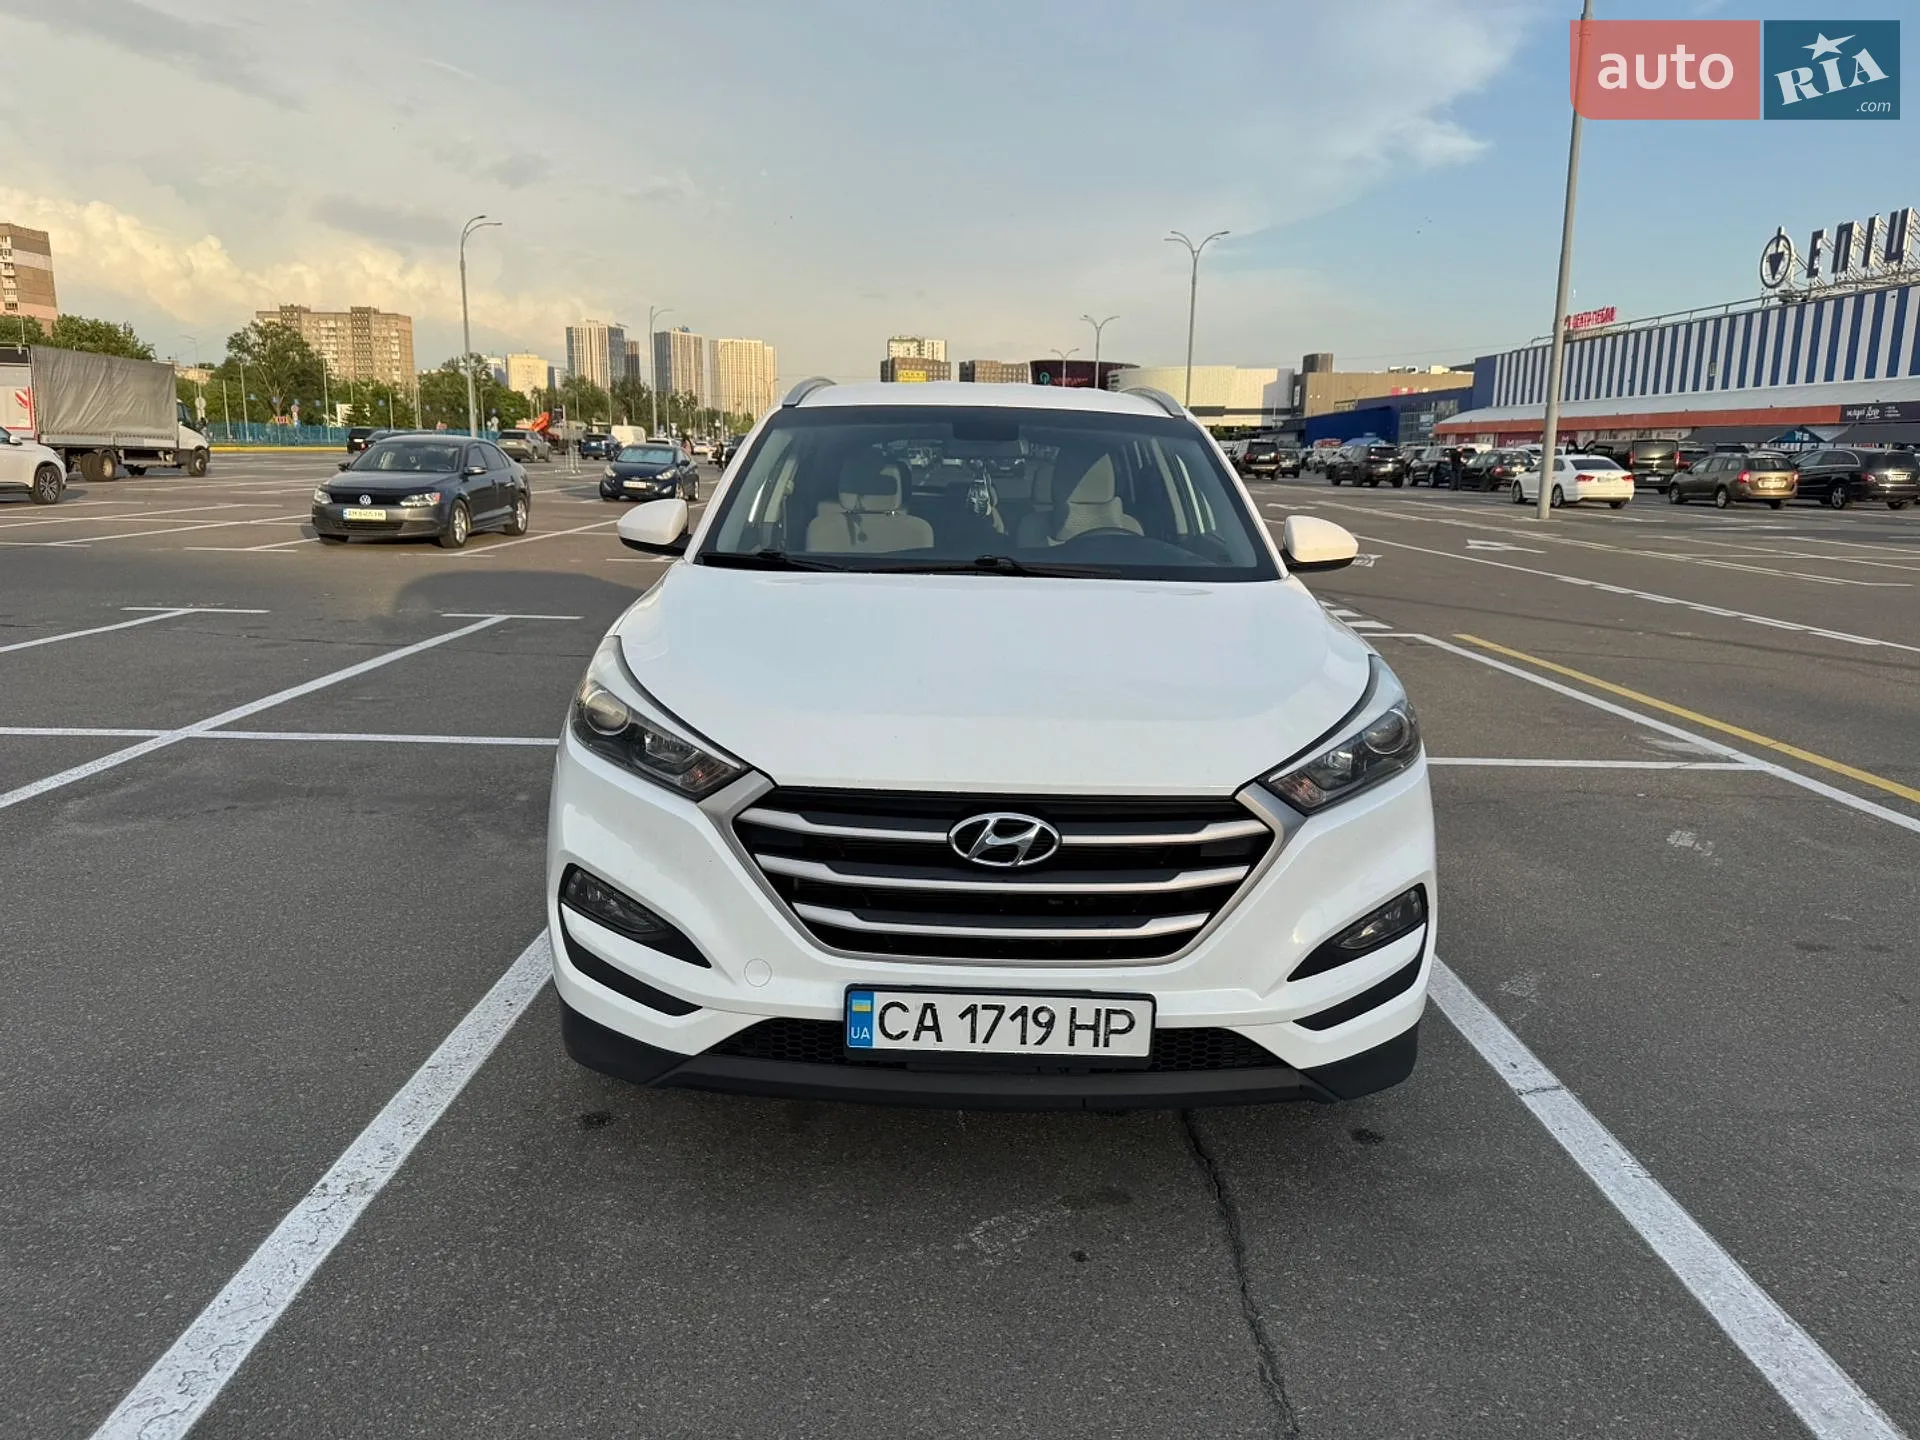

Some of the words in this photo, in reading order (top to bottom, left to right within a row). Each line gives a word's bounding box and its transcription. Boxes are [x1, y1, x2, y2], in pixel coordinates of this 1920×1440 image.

[851, 1027, 871, 1040] UA
[878, 1001, 943, 1042] CA
[958, 1003, 1056, 1046] 1719
[1067, 1006, 1136, 1048] HP
